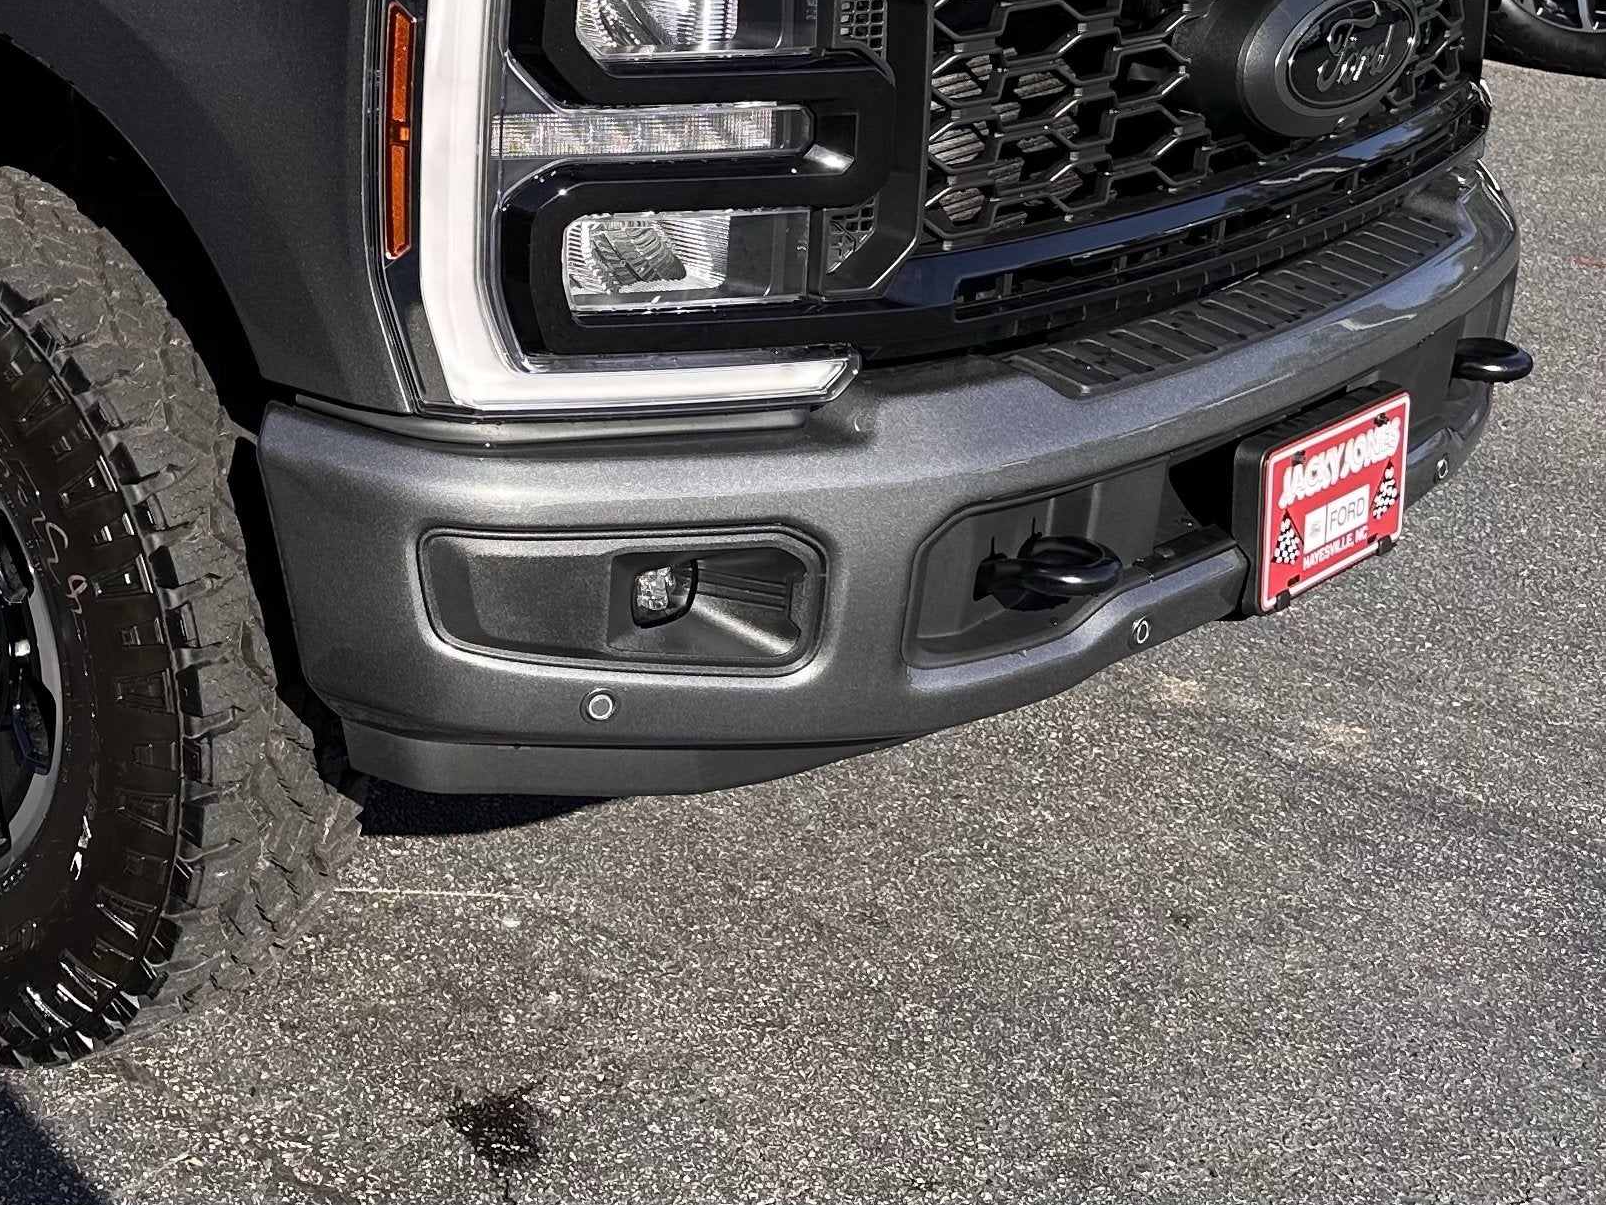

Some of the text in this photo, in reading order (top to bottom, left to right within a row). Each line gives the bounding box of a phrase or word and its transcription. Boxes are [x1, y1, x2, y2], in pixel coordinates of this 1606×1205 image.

[1316, 0, 1395, 93] Ford
[1278, 416, 1401, 509] JACKY JONES
[1330, 497, 1365, 531] FORD
[1354, 524, 1369, 544] NC
